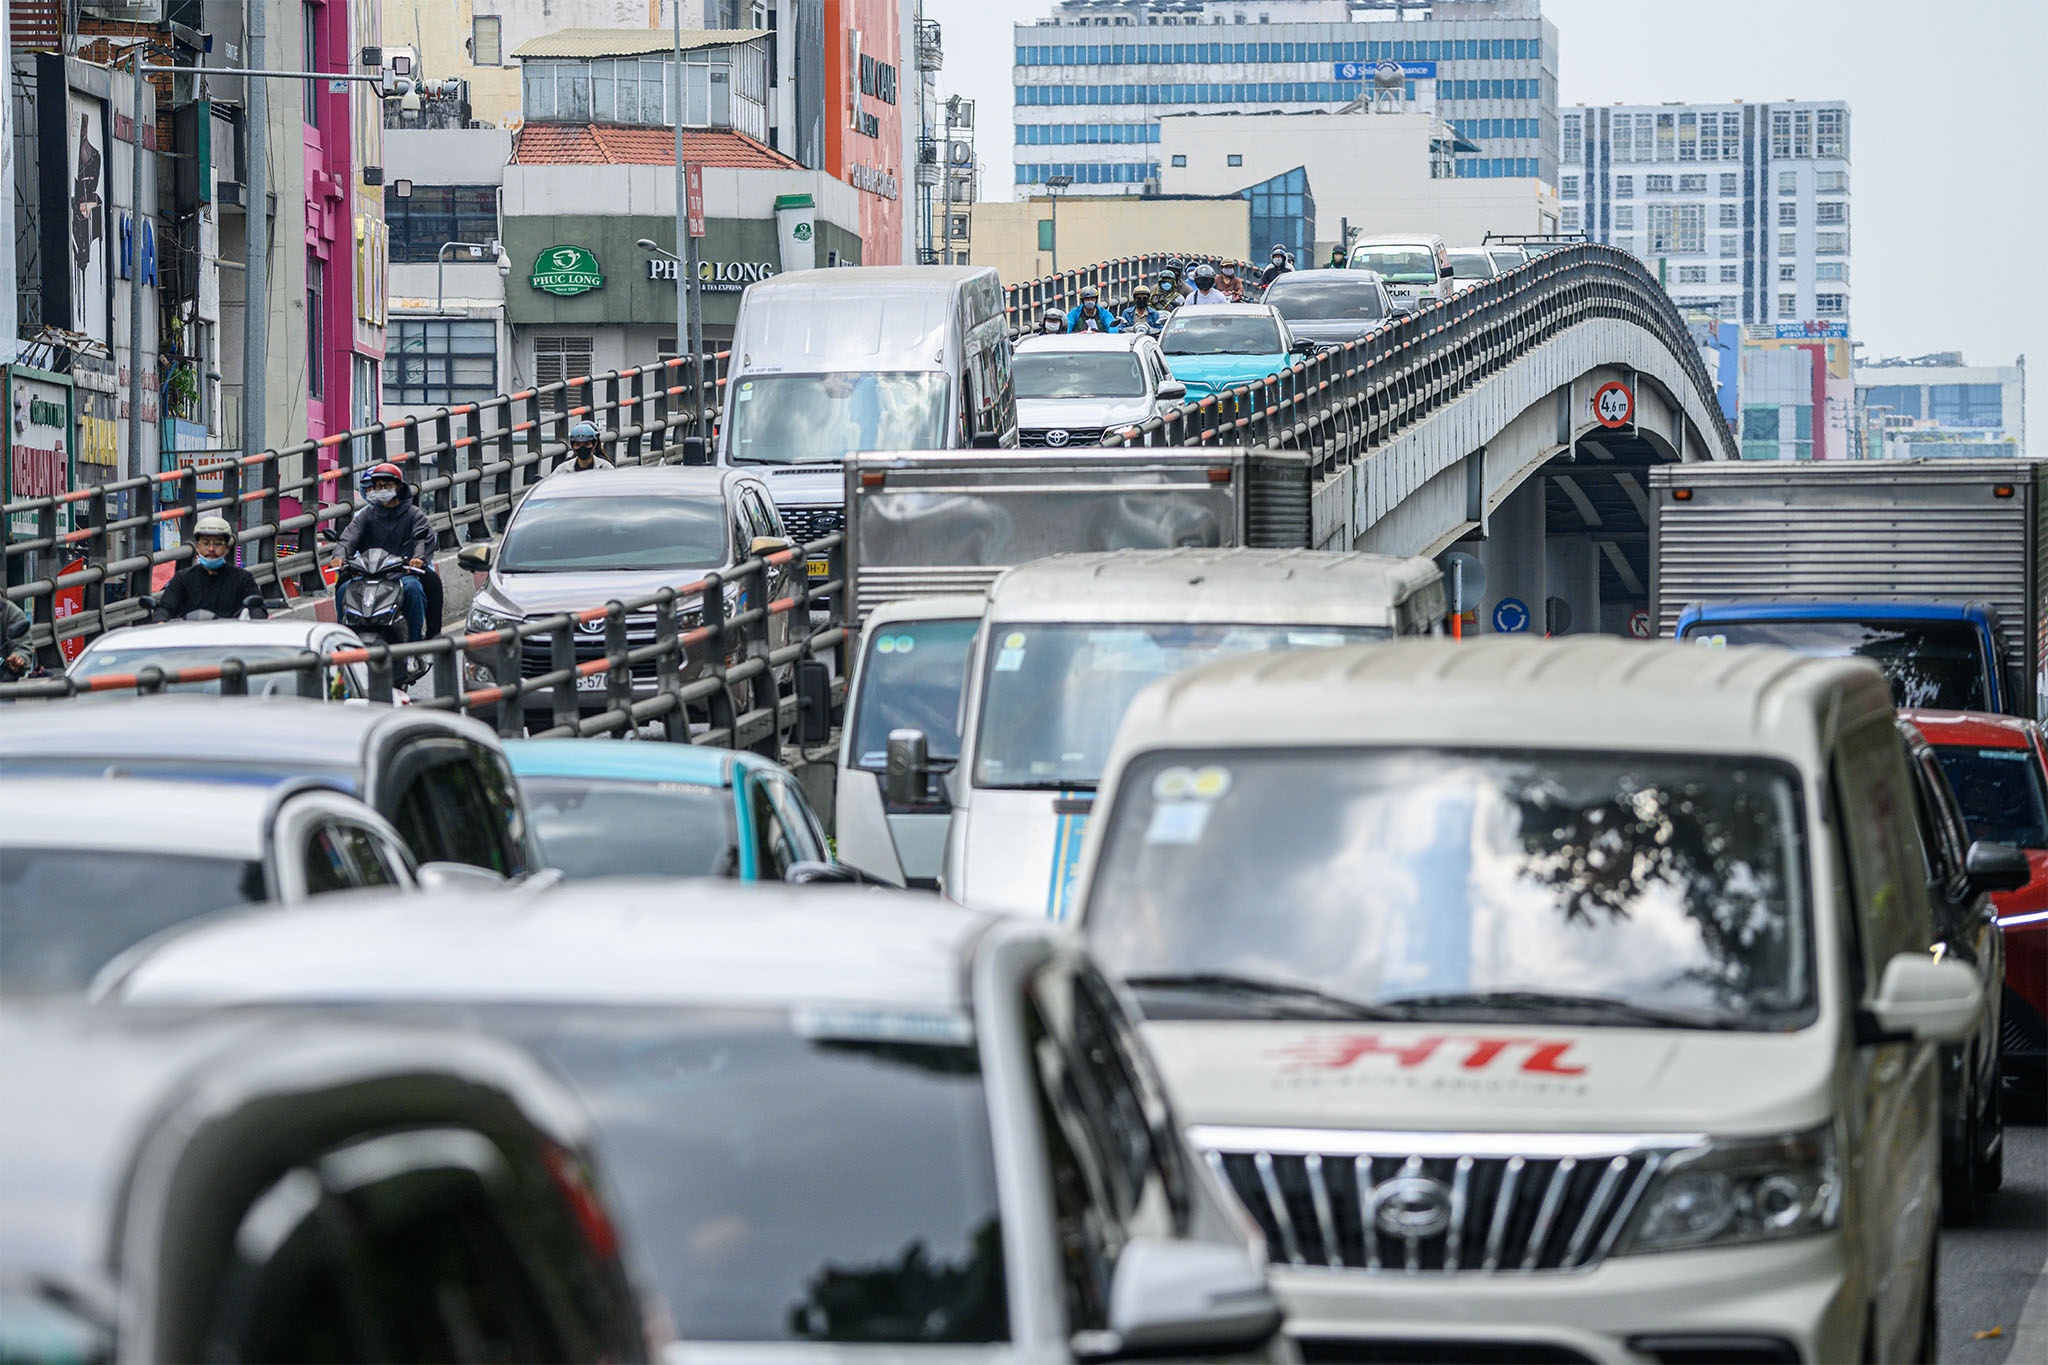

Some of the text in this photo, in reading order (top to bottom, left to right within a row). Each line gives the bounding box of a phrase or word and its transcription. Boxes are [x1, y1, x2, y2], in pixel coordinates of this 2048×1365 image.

[532, 274, 601, 286] PHUC LONG
[650, 259, 774, 282] PHC LONG
[1618, 403, 1627, 412] m
[33, 448, 50, 498] LAN
[1315, 1033, 1588, 1077] HTL
